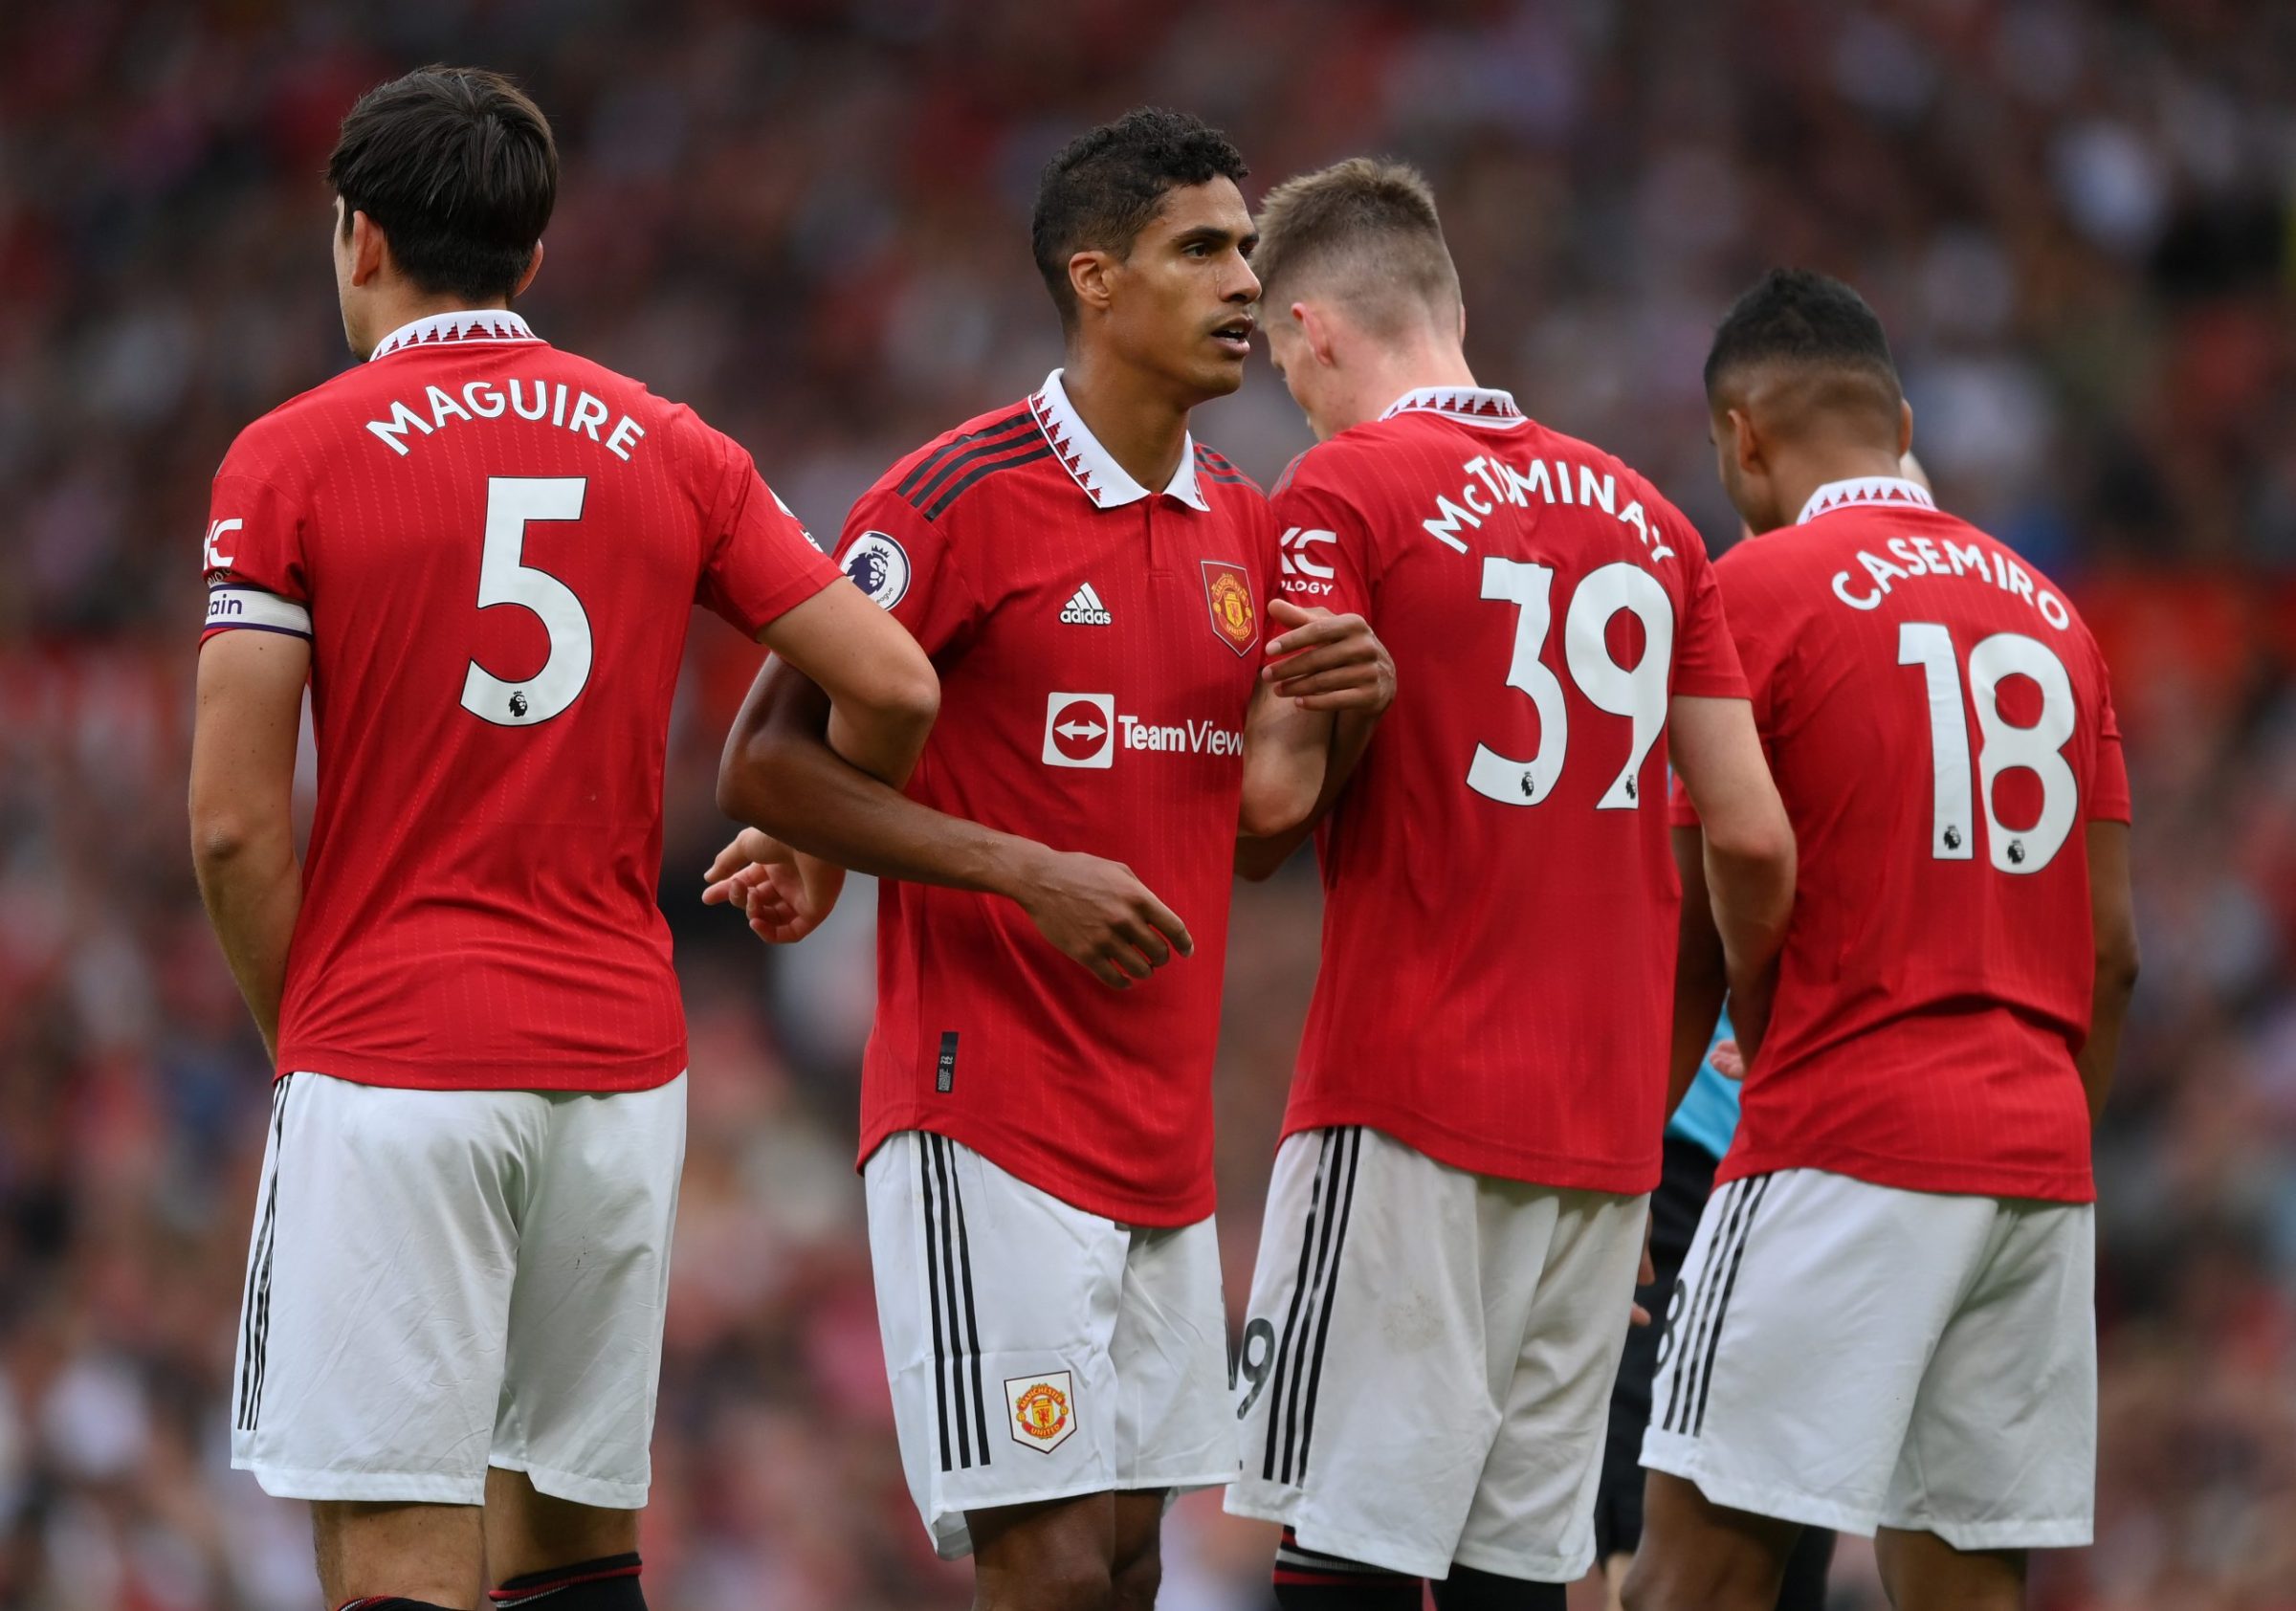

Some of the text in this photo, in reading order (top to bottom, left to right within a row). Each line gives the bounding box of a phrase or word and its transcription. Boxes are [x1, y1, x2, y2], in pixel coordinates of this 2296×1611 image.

[366, 379, 646, 462] MAGUIRE
[209, 593, 243, 615] ain
[460, 476, 592, 726] 5
[875, 586, 894, 605] eague
[1280, 580, 1334, 596] LOGY
[1831, 538, 2070, 630] CASEMIRO
[1059, 608, 1112, 625] adidas
[1466, 557, 1674, 809] 39
[1117, 715, 1244, 757] TeamView
[1897, 622, 2078, 874] 18
[1236, 1317, 1276, 1421] 9
[1020, 1386, 1064, 1408] MANCHESTER
[1030, 1423, 1061, 1436] UNITED
